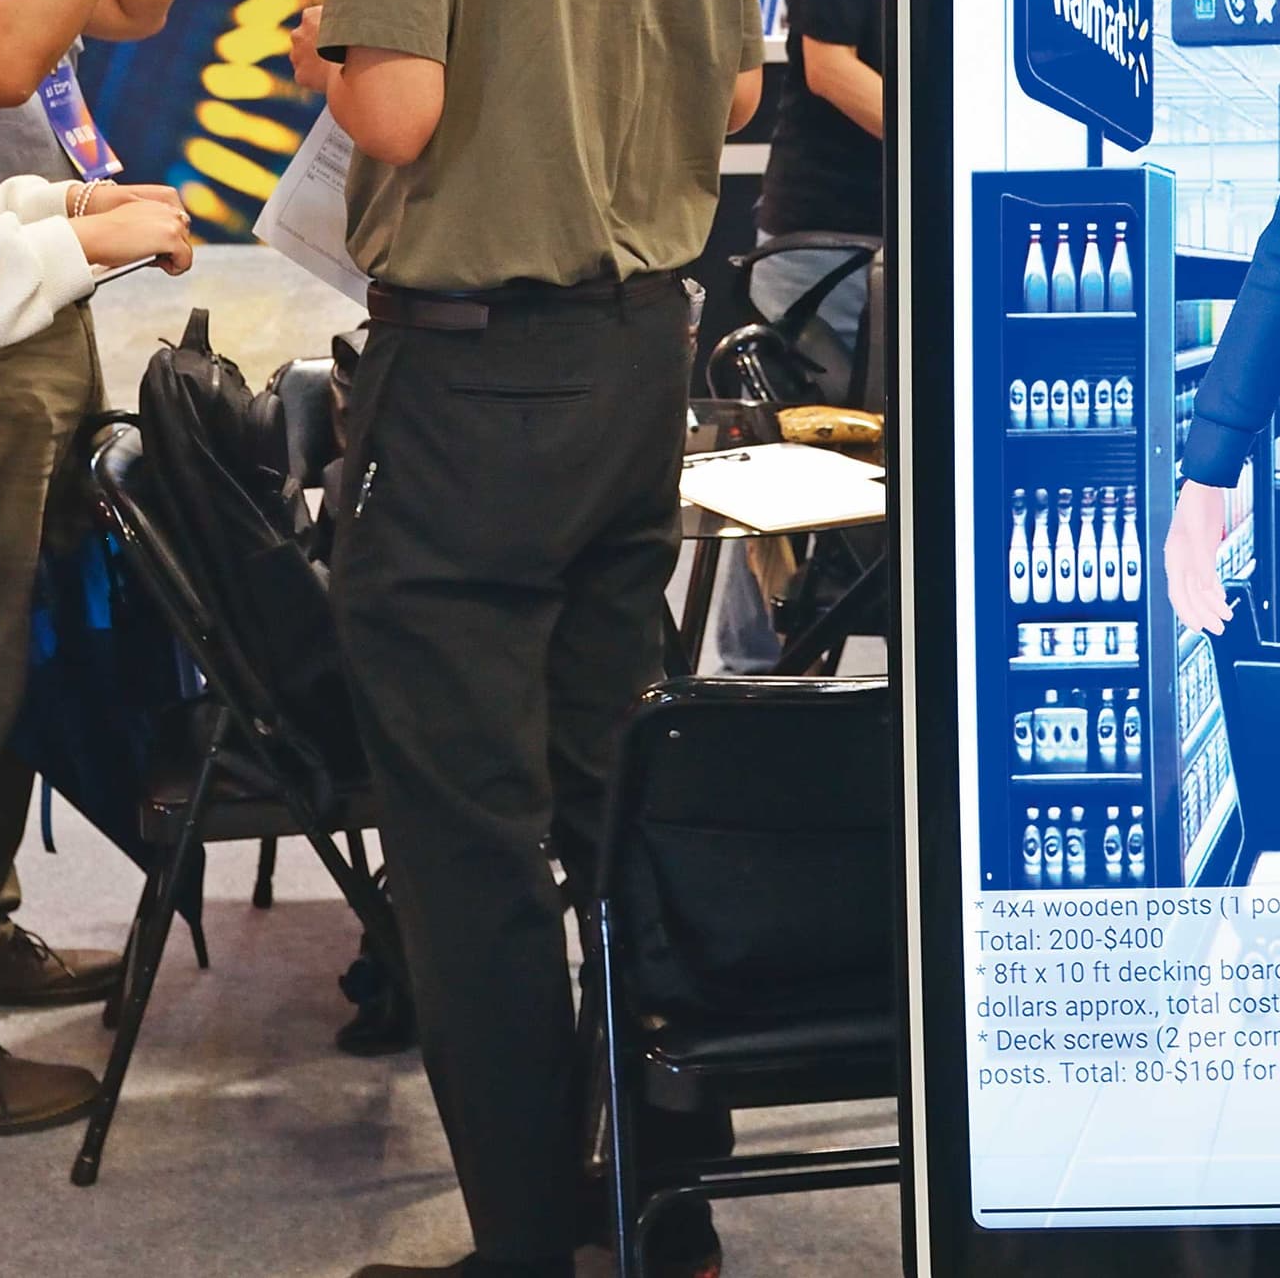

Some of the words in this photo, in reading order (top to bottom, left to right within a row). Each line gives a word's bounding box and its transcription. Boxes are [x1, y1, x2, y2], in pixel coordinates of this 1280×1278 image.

[991, 899, 1036, 919] 4x4
[1042, 898, 1139, 918] wooden
[1146, 897, 1212, 922] posts
[1220, 895, 1239, 920] (1
[975, 928, 1041, 952] Total:
[1048, 925, 1164, 952] 200-$400
[994, 961, 1028, 985] 8ft
[1034, 967, 1048, 984] x
[1055, 961, 1085, 984] 10
[1092, 959, 1111, 983] ft
[1118, 959, 1212, 987] decking
[976, 994, 1058, 1018] dollars
[1065, 998, 1159, 1023] approx.,
[1165, 991, 1220, 1015] total
[1228, 993, 1280, 1014] cost
[996, 1027, 1057, 1051] Deck
[1063, 1032, 1149, 1050] screws
[1156, 1025, 1180, 1054] (2
[1188, 1030, 1227, 1054] per
[979, 1064, 1052, 1091] posts.
[1058, 1060, 1127, 1084] Total:
[1135, 1059, 1235, 1084] 80-$160
[1242, 1059, 1275, 1081] for
